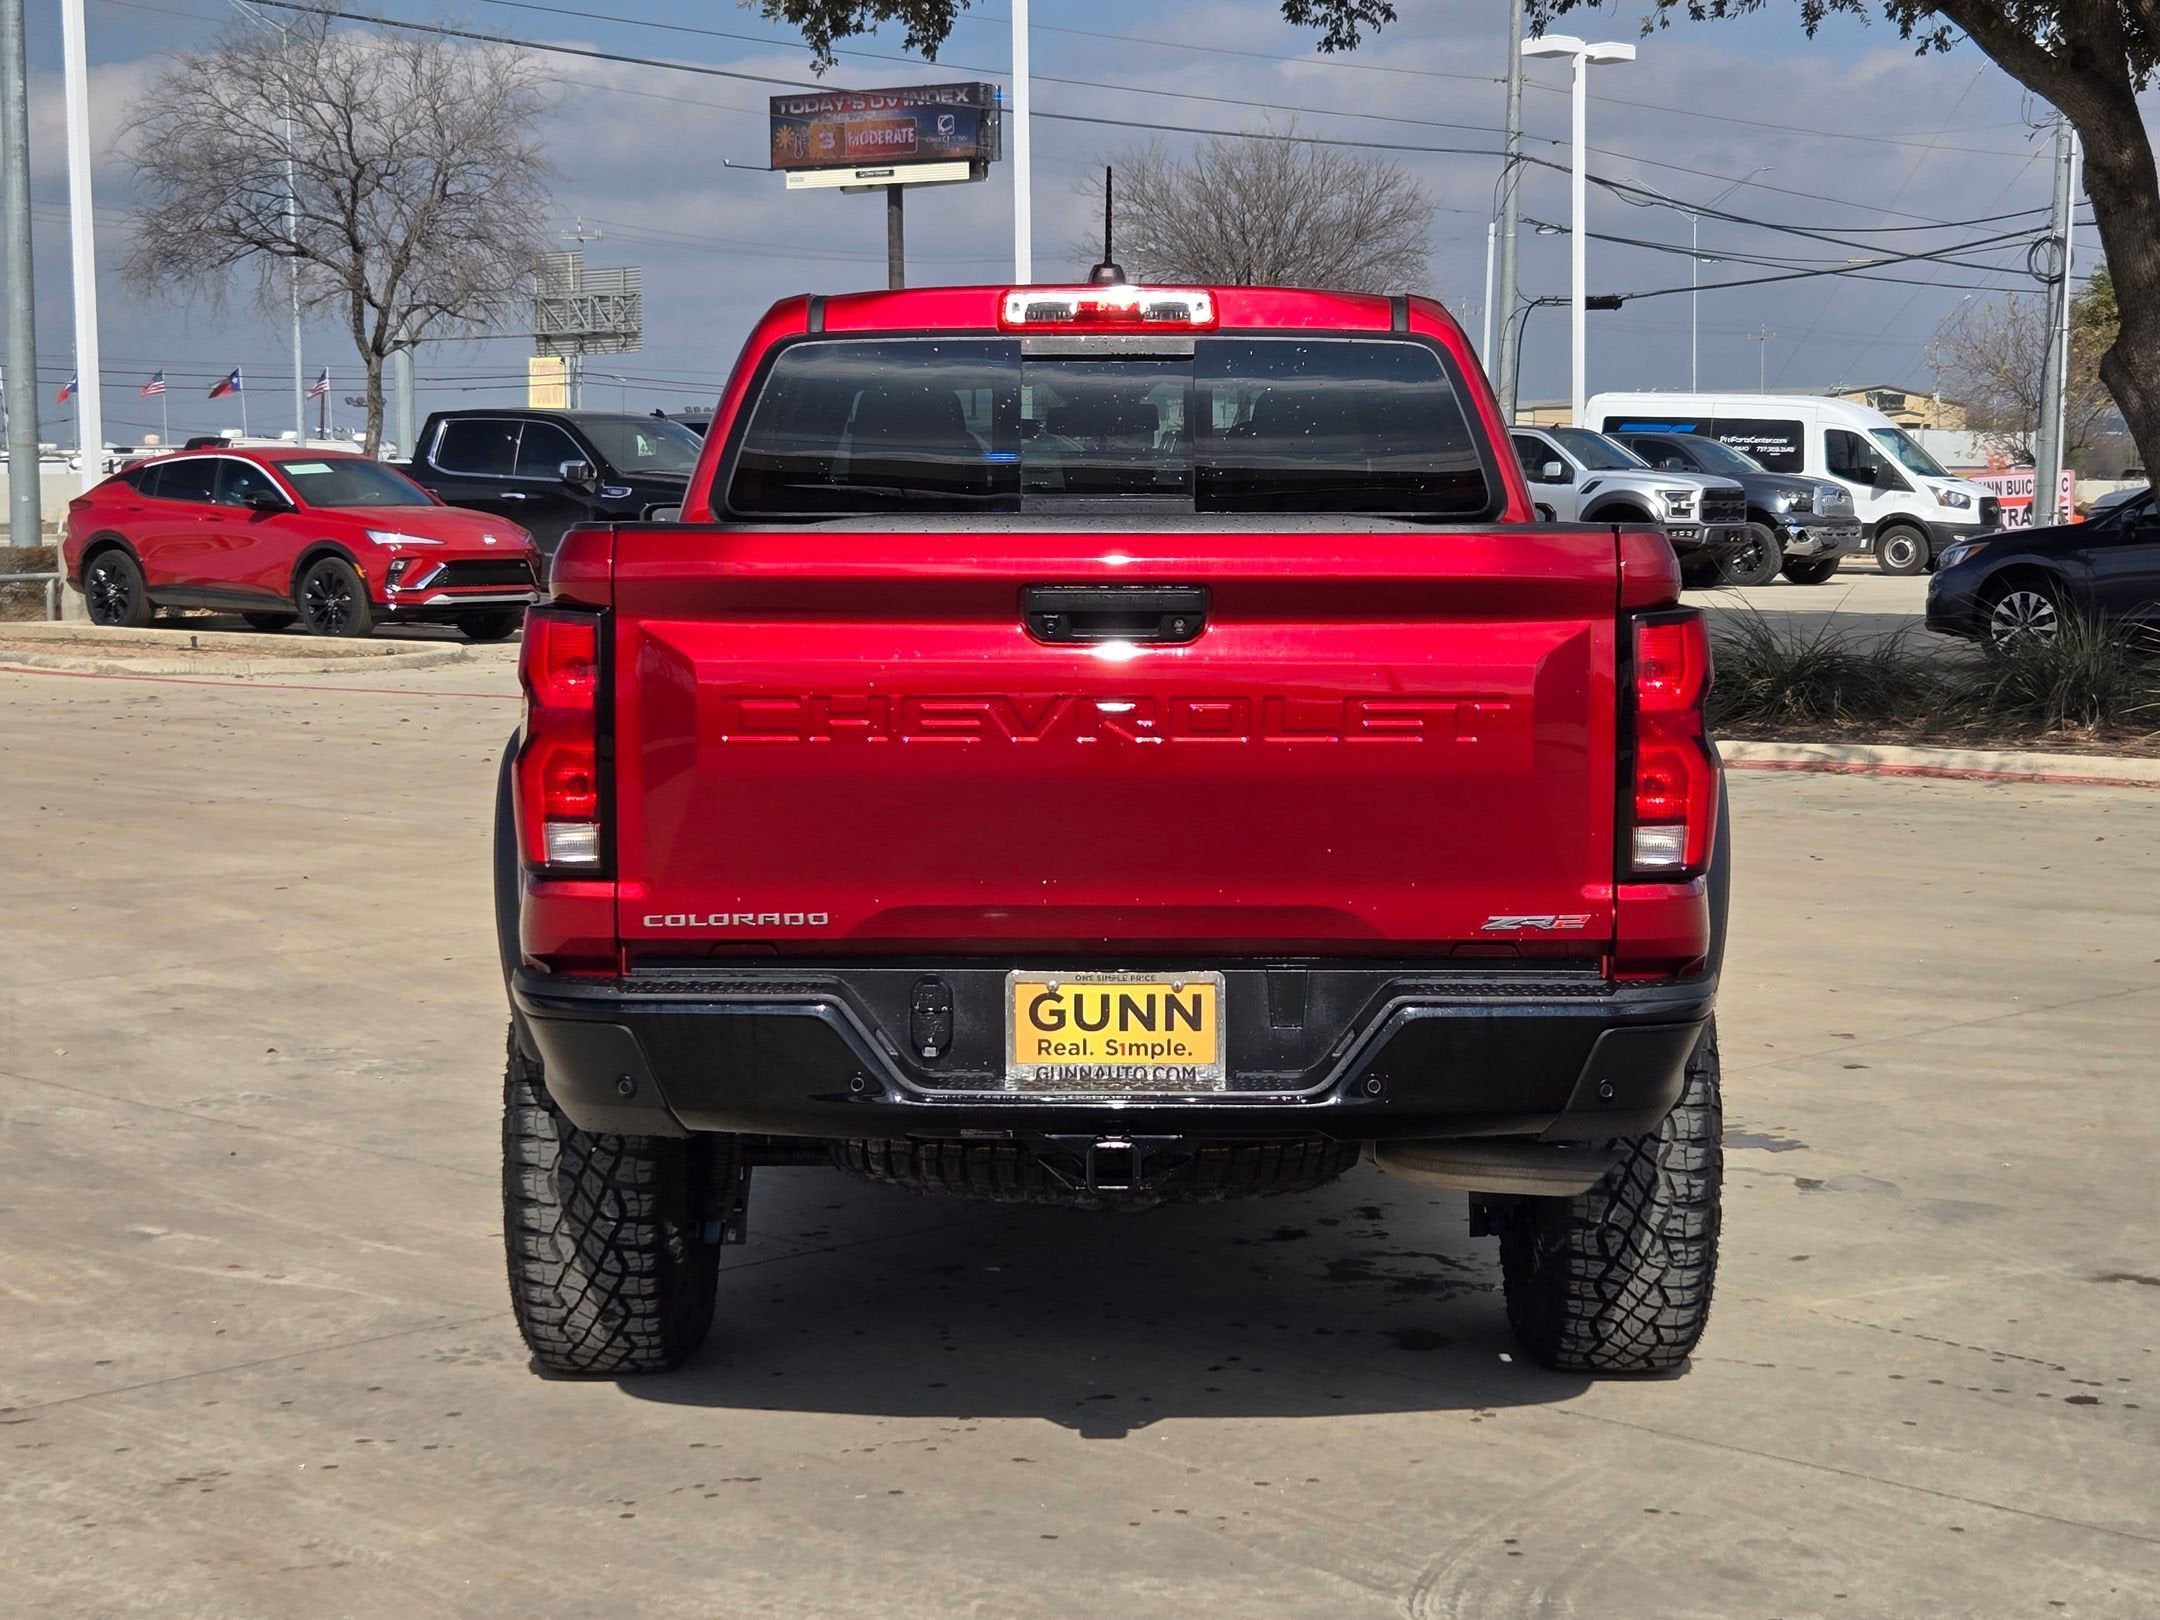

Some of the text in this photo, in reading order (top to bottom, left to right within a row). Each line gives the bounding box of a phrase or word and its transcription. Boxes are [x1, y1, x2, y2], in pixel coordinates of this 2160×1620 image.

[780, 88, 969, 114] TODAY'S UV INDEX
[819, 131, 835, 149] 3
[848, 128, 915, 147] MODERATE
[2006, 479, 2033, 496] BUIC
[720, 694, 1511, 742] CHEVROLET
[642, 911, 830, 928] COLORADO
[1480, 913, 1592, 930] ZR2
[1075, 974, 1156, 982] ONE SIMPLE PRICE
[1028, 992, 1203, 1032] GUNN
[1037, 1038, 1094, 1057] Real.
[1035, 1065, 1197, 1081] GUNNAUTOCOM
